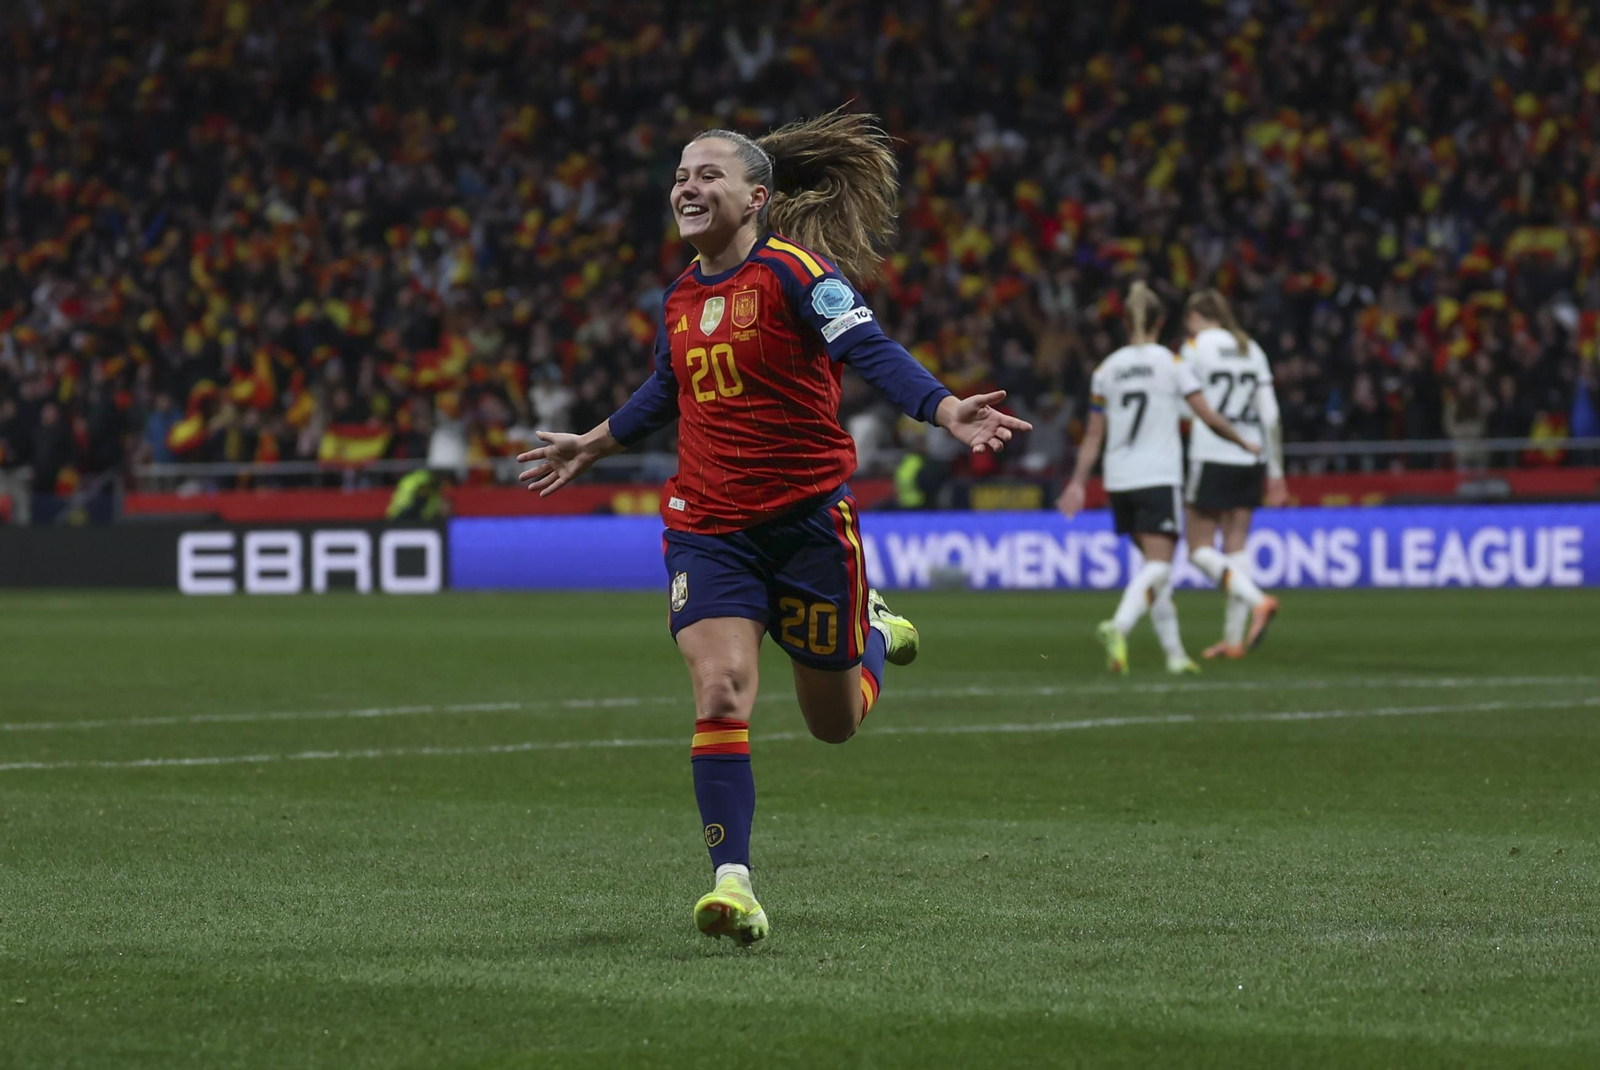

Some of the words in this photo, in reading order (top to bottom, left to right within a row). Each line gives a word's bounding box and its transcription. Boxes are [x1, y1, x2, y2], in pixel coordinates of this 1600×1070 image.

[686, 343, 743, 403] 20
[1210, 371, 1260, 423] 22
[1122, 391, 1148, 445] 7
[178, 530, 443, 595] EBRO
[886, 531, 1121, 589] WOMEN'S
[1128, 527, 1361, 589] AONS
[1370, 526, 1584, 588] LEAGUE
[779, 596, 838, 655] 20
